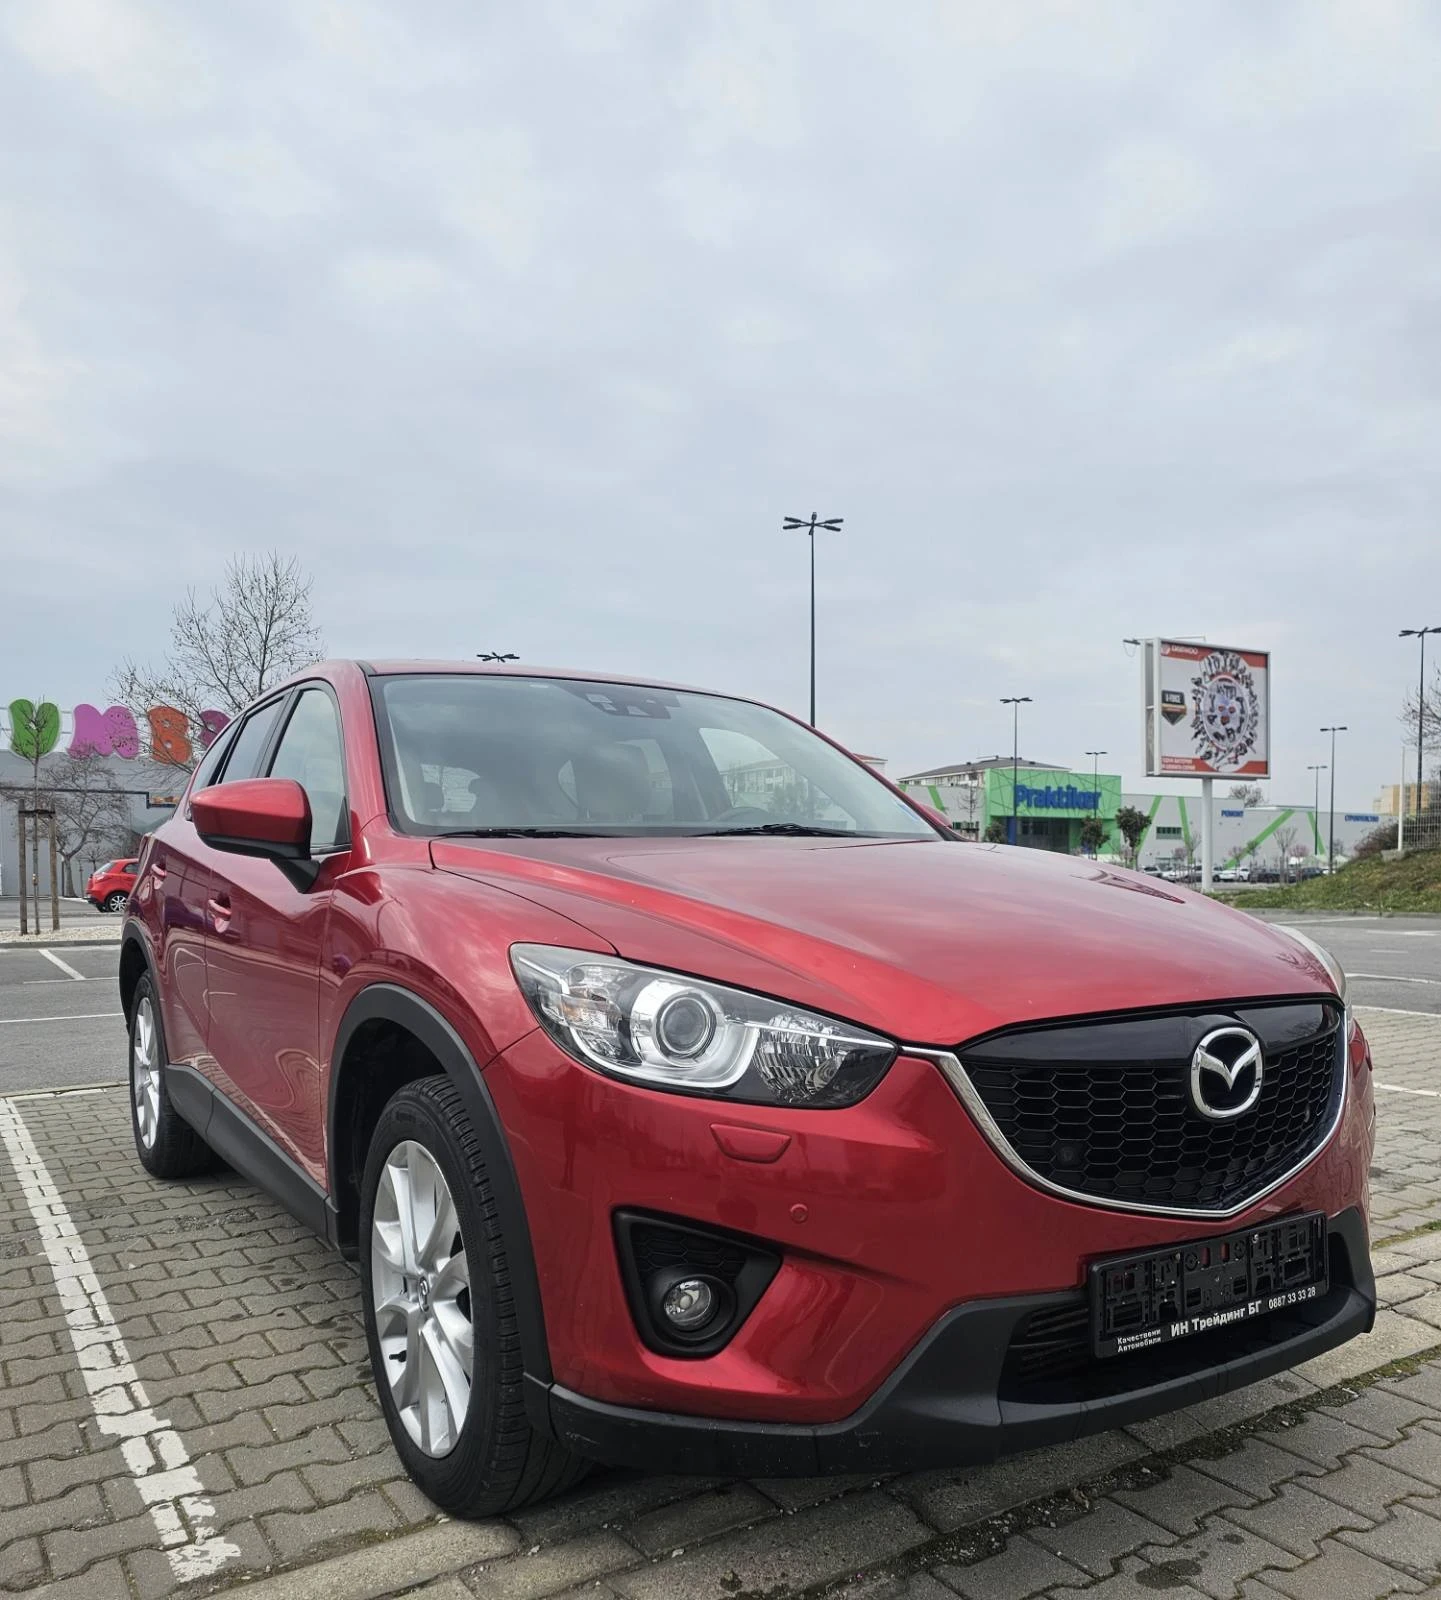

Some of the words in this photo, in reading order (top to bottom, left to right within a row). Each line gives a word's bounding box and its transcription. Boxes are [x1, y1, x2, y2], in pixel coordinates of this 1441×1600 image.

[1014, 784, 1102, 810] Praktiker
[1170, 1321, 1189, 1337] ИН
[1191, 1308, 1246, 1331] Трейдинг
[1248, 1300, 1262, 1316] БГ
[1268, 1297, 1286, 1309] 0887
[1287, 1292, 1297, 1304] 33
[1297, 1289, 1307, 1301] 33
[1307, 1286, 1316, 1297] 28
[1117, 1337, 1161, 1353] Автомобили
